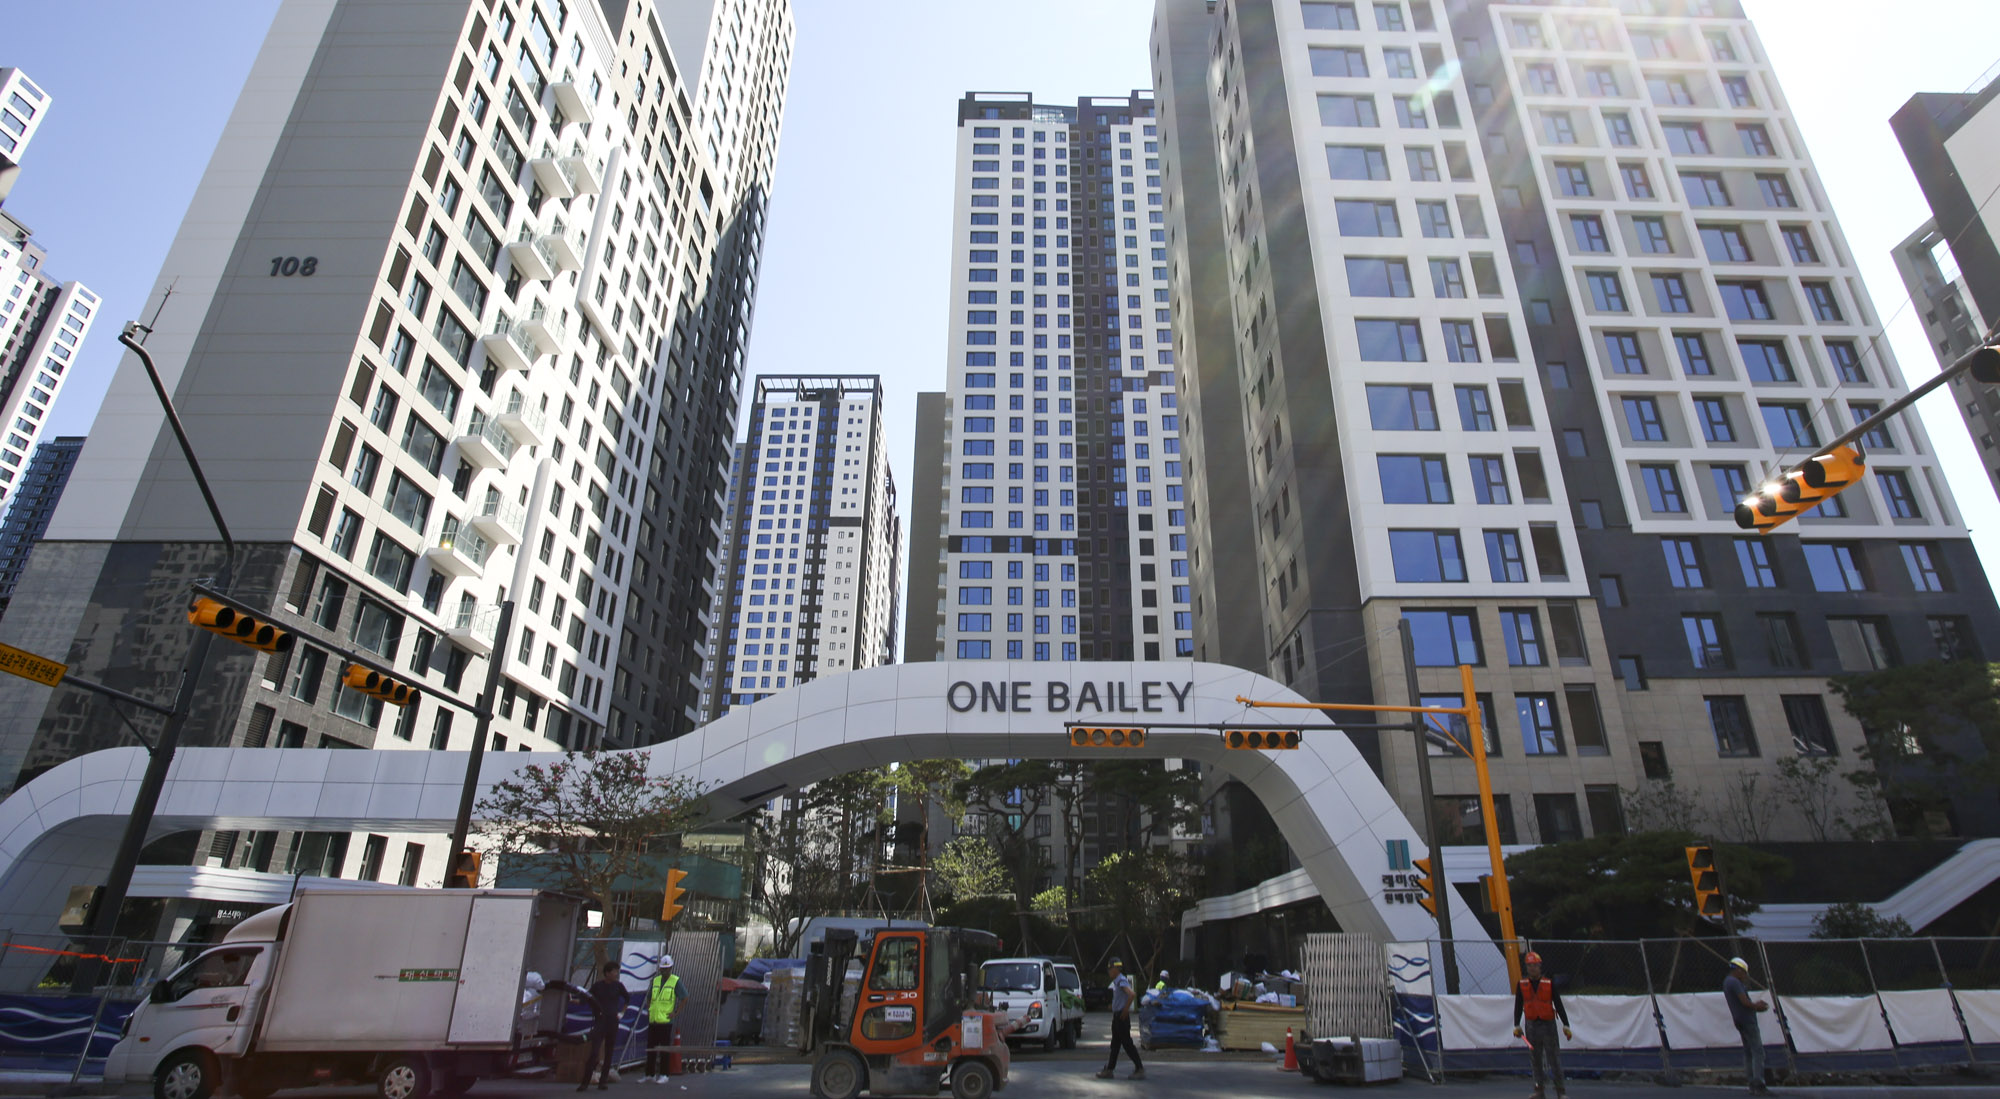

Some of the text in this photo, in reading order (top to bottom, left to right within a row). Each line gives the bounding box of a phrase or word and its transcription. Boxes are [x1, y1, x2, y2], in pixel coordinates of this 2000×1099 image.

[270, 256, 318, 277] 108
[947, 680, 1193, 713] ONE BAILEY
[1382, 874, 1420, 888] 래미안
[900, 991, 918, 1000] 30
